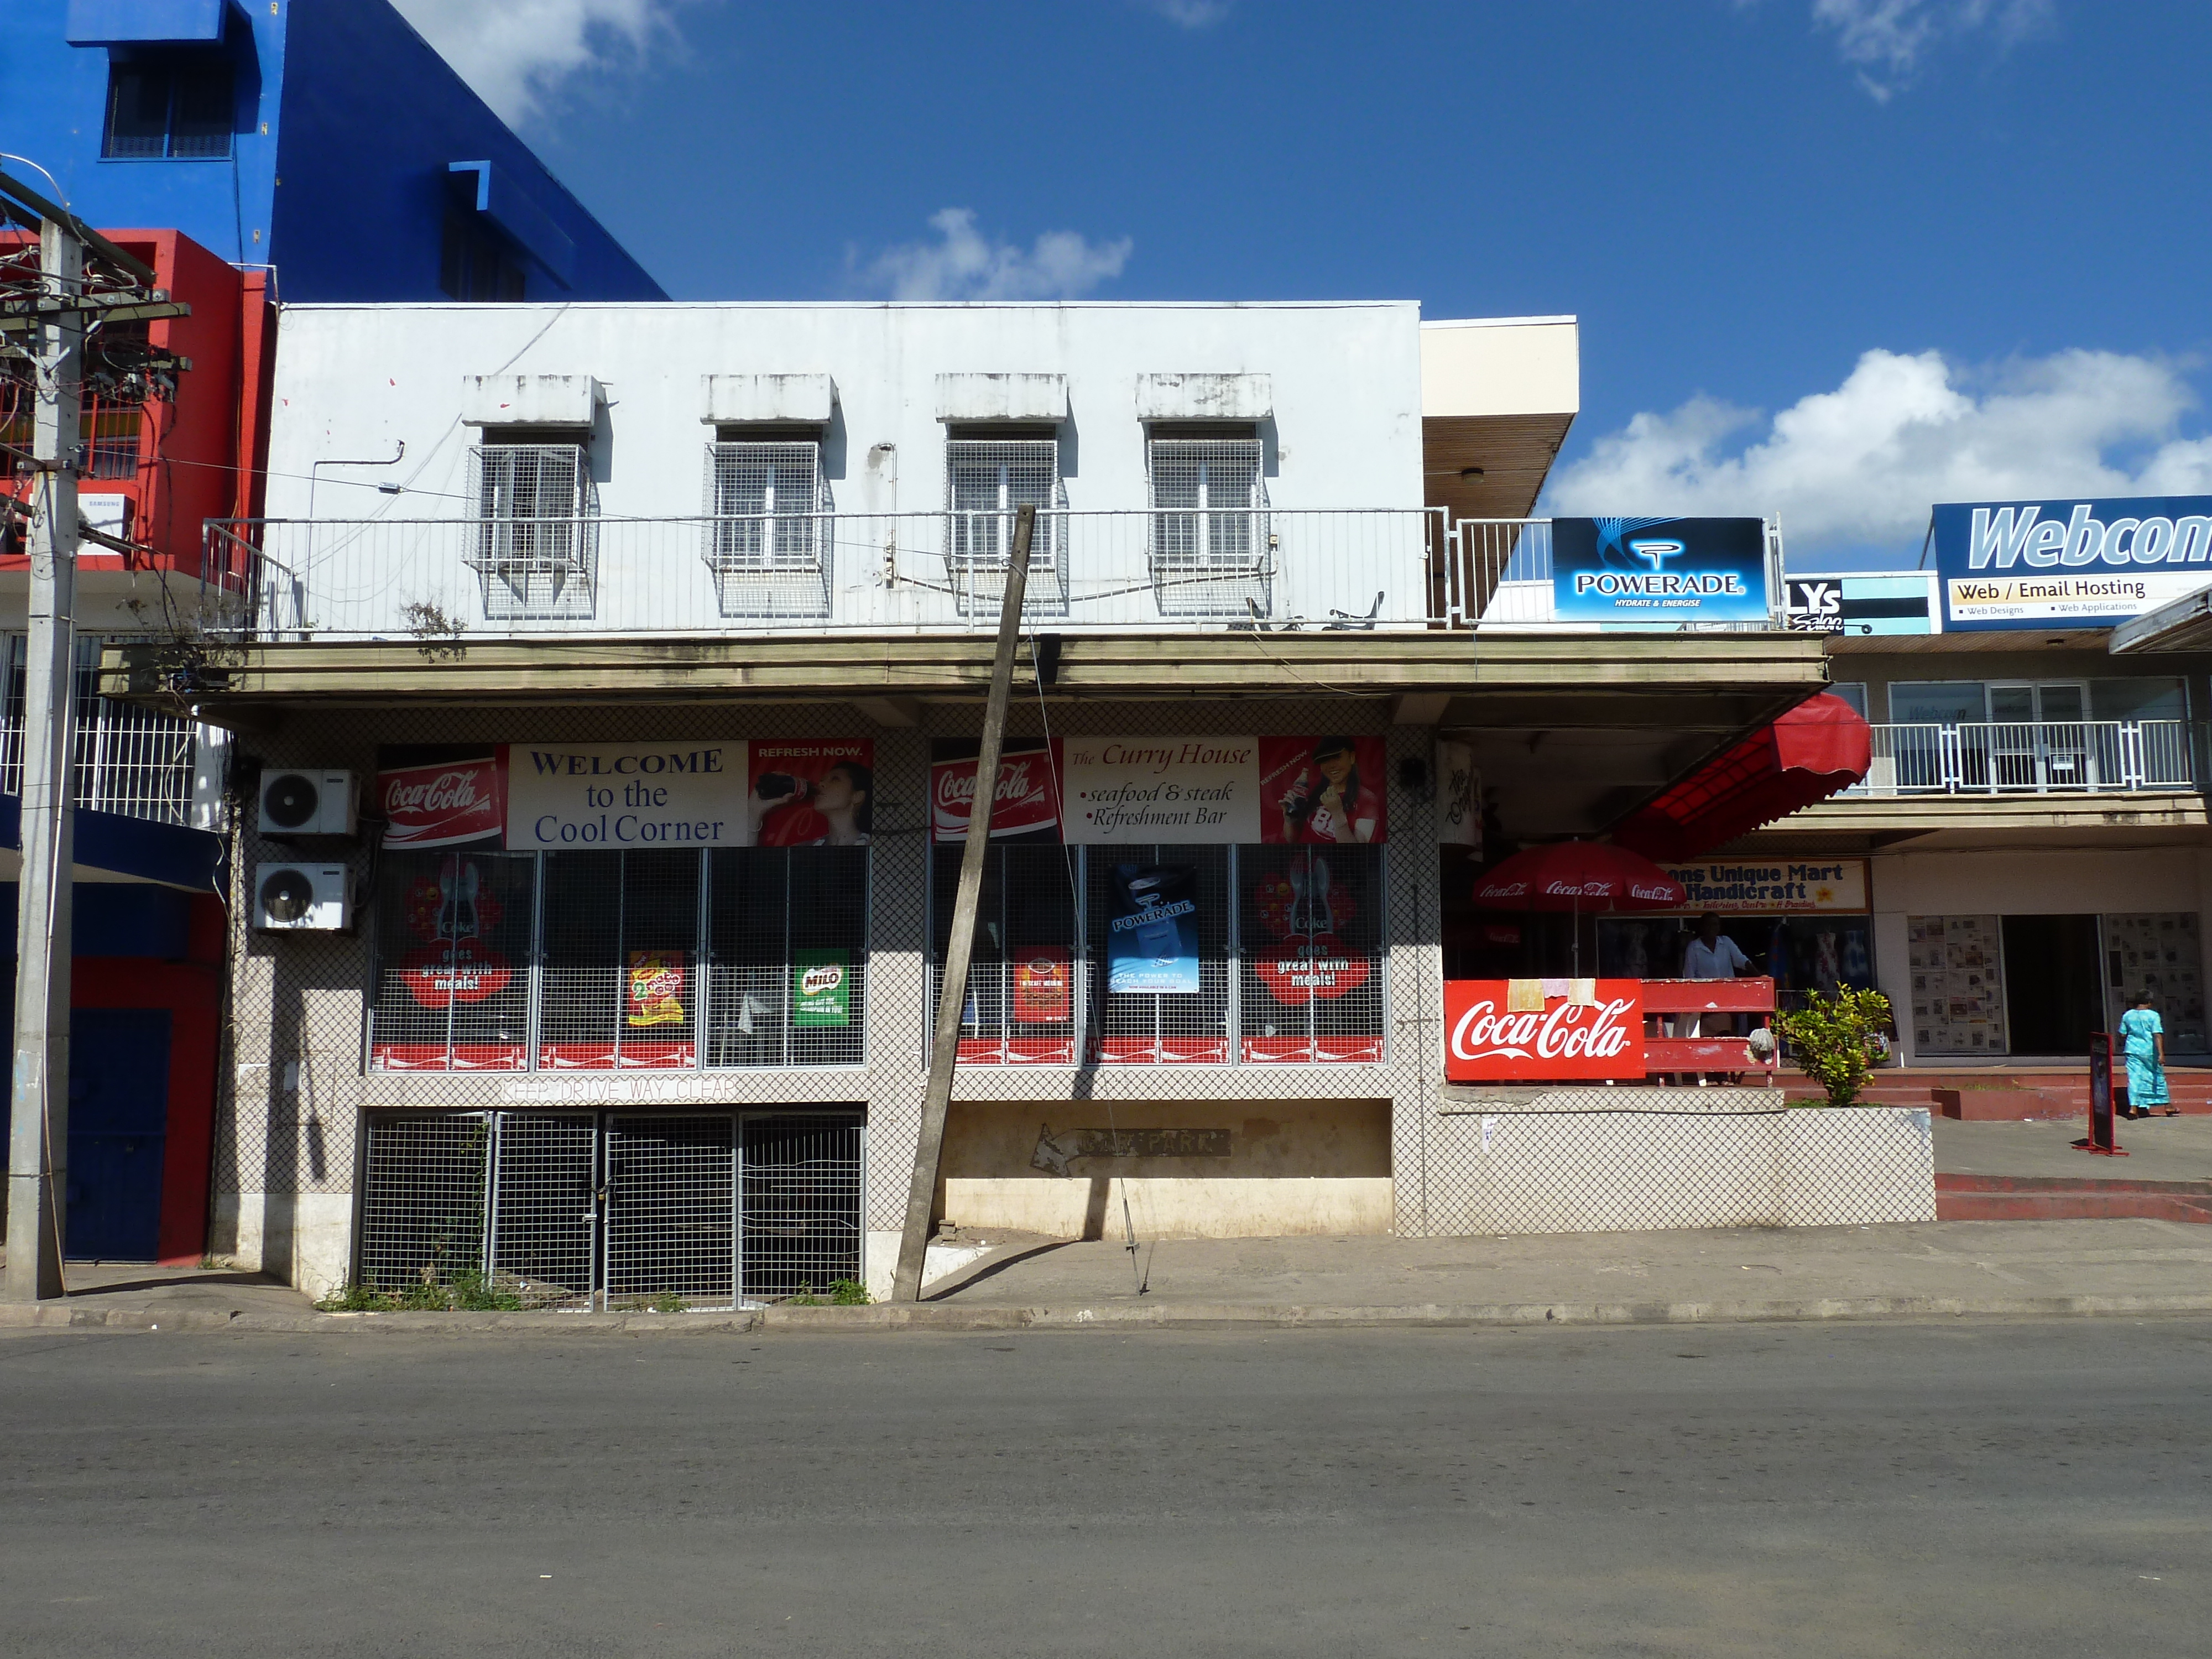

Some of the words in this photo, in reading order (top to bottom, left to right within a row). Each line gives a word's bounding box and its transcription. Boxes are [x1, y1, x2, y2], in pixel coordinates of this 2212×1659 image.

[1577, 575, 1737, 593] POWERADE
[1957, 583, 1999, 599] Web
[2020, 581, 2070, 597] Email
[2076, 579, 2145, 598] Hosting
[1614, 599, 1651, 607] HYDRATE
[1653, 599, 1659, 607] &
[1662, 599, 1700, 607] ENERGISE
[1990, 606, 2024, 615] Designs
[2081, 602, 2137, 613] Applications
[530, 748, 723, 775] WELCOME
[758, 747, 820, 757] REFRESH
[823, 747, 863, 757] NOW.
[1073, 750, 1094, 765] The
[1103, 744, 1173, 774] Curry
[1176, 744, 1251, 764] House
[938, 760, 1032, 806] Cocaola
[1260, 763, 1290, 785] REFRESH
[385, 768, 479, 815] Coca-Cola
[586, 784, 614, 807] to
[624, 780, 667, 807] the
[1088, 782, 1166, 810] seafood
[1166, 784, 1183, 801] &
[1185, 781, 1234, 801] steak
[535, 815, 608, 842] Cool
[615, 815, 724, 842] Corner
[1093, 805, 1191, 833] Refreshment
[1195, 807, 1227, 825] Bar
[1711, 866, 1781, 885] Unique
[1788, 864, 1843, 881] Mart
[1687, 883, 1806, 901] Handicraft
[1113, 902, 1191, 931] POWERADE
[422, 964, 454, 978] grea
[461, 960, 492, 975] with
[1318, 956, 1348, 971] with
[435, 975, 478, 990] meals!
[805, 973, 839, 988] MILO
[1291, 971, 1335, 986] meals!
[1451, 998, 1636, 1060] Coca-Cola
[503, 1082, 549, 1100] KEEP
[561, 1081, 619, 1100] DRIVE
[630, 1081, 665, 1099] WAY
[676, 1080, 737, 1099] CLEAR
[1149, 1132, 1213, 1153] PARK
